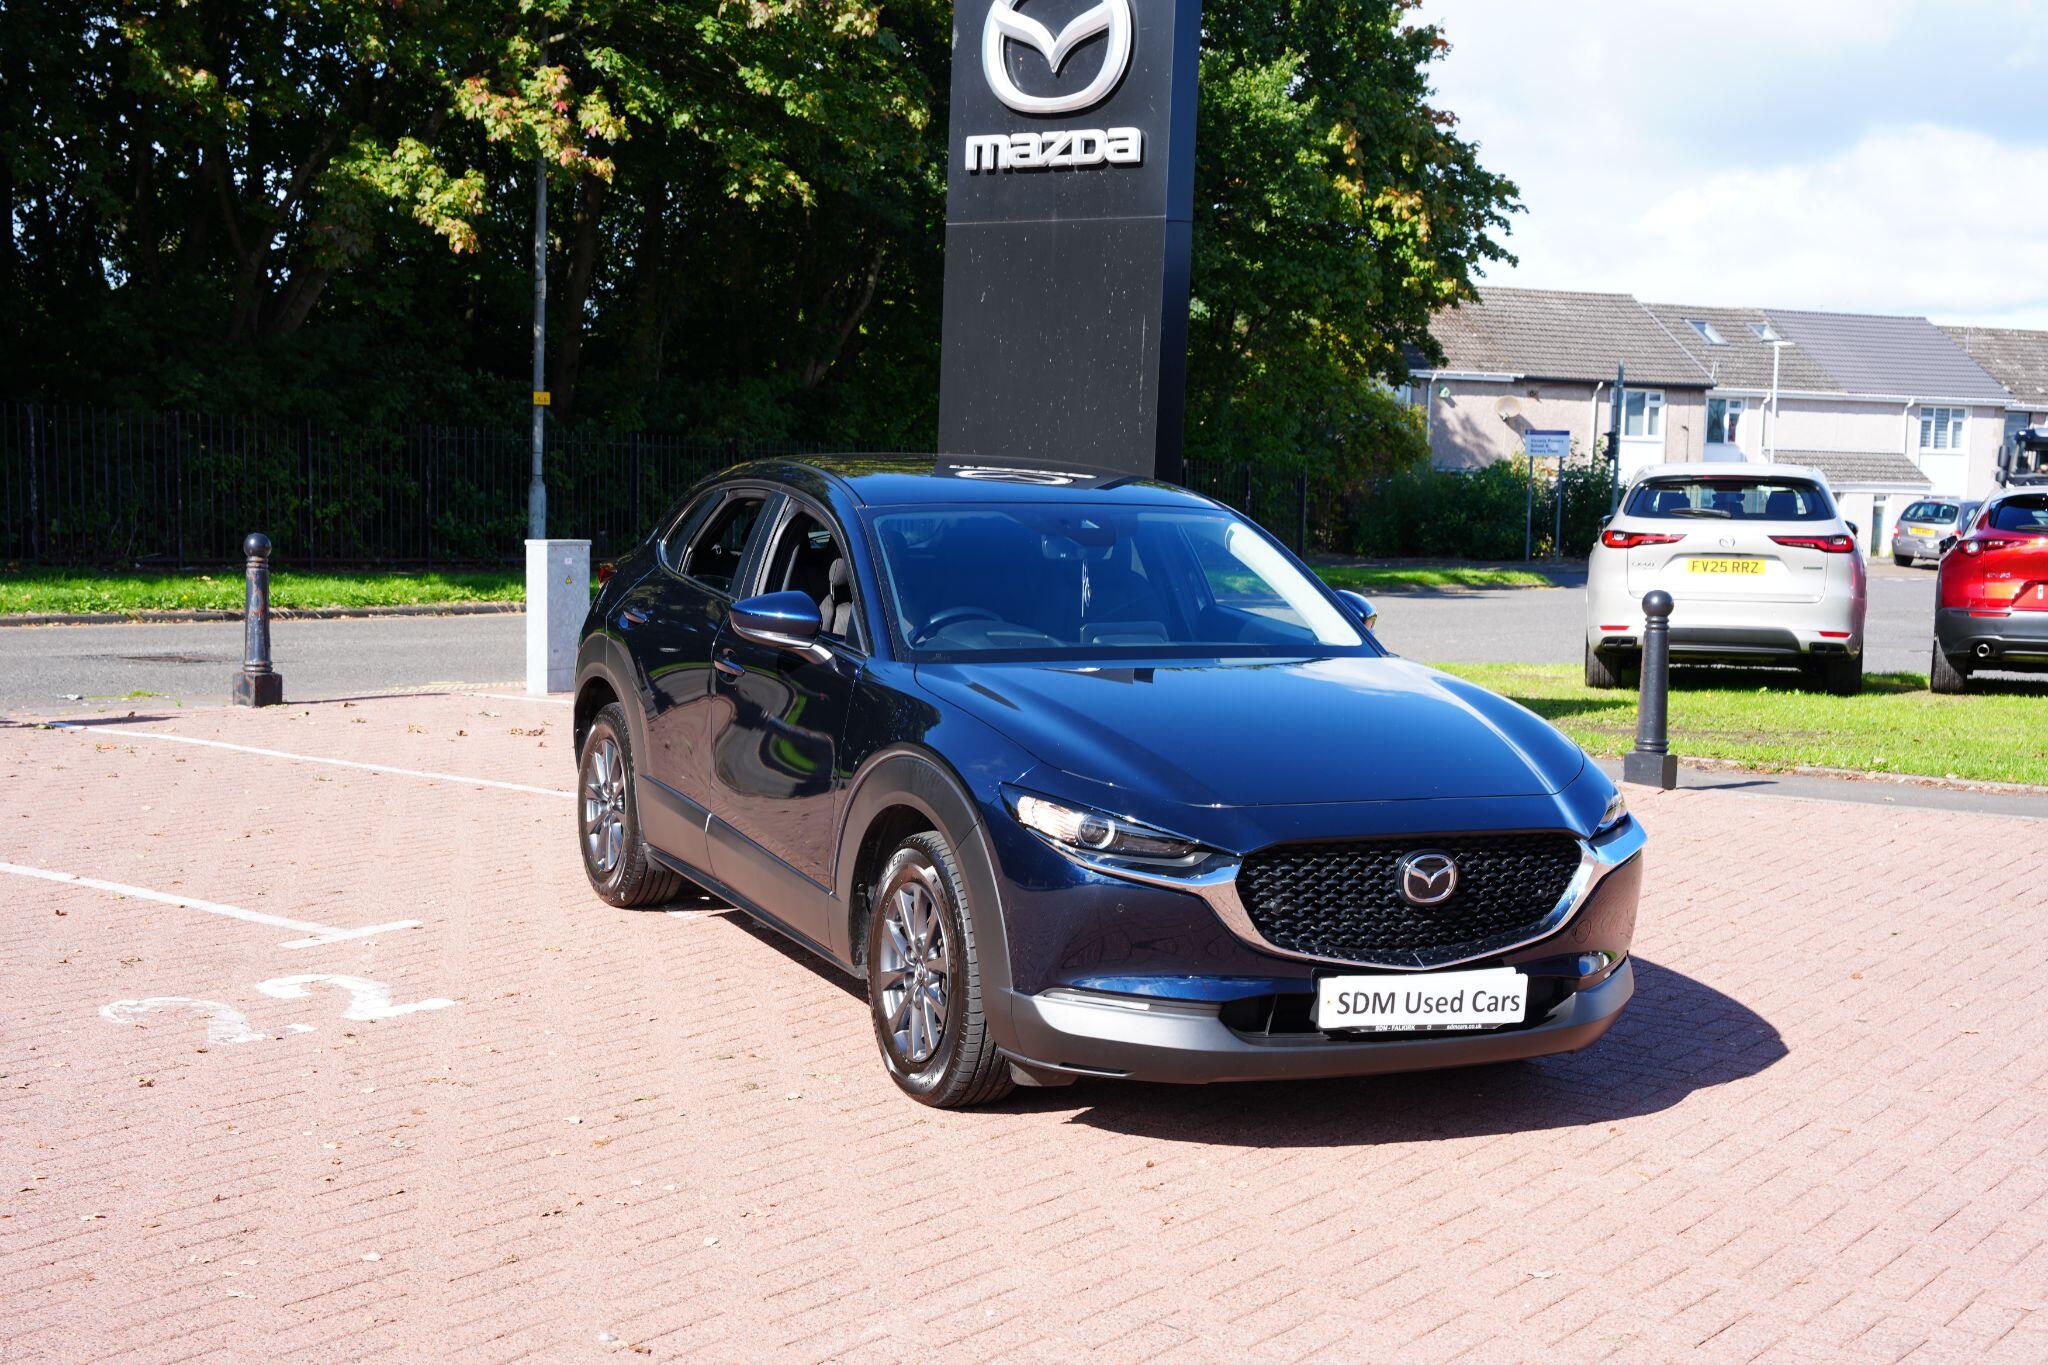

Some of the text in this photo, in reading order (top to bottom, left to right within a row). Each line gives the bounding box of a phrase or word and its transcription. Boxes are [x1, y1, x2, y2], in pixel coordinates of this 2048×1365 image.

[965, 127, 1142, 171] mazda
[1692, 560, 1759, 574] FV25 RRZ
[1336, 990, 1521, 1015] SDM Used Cars
